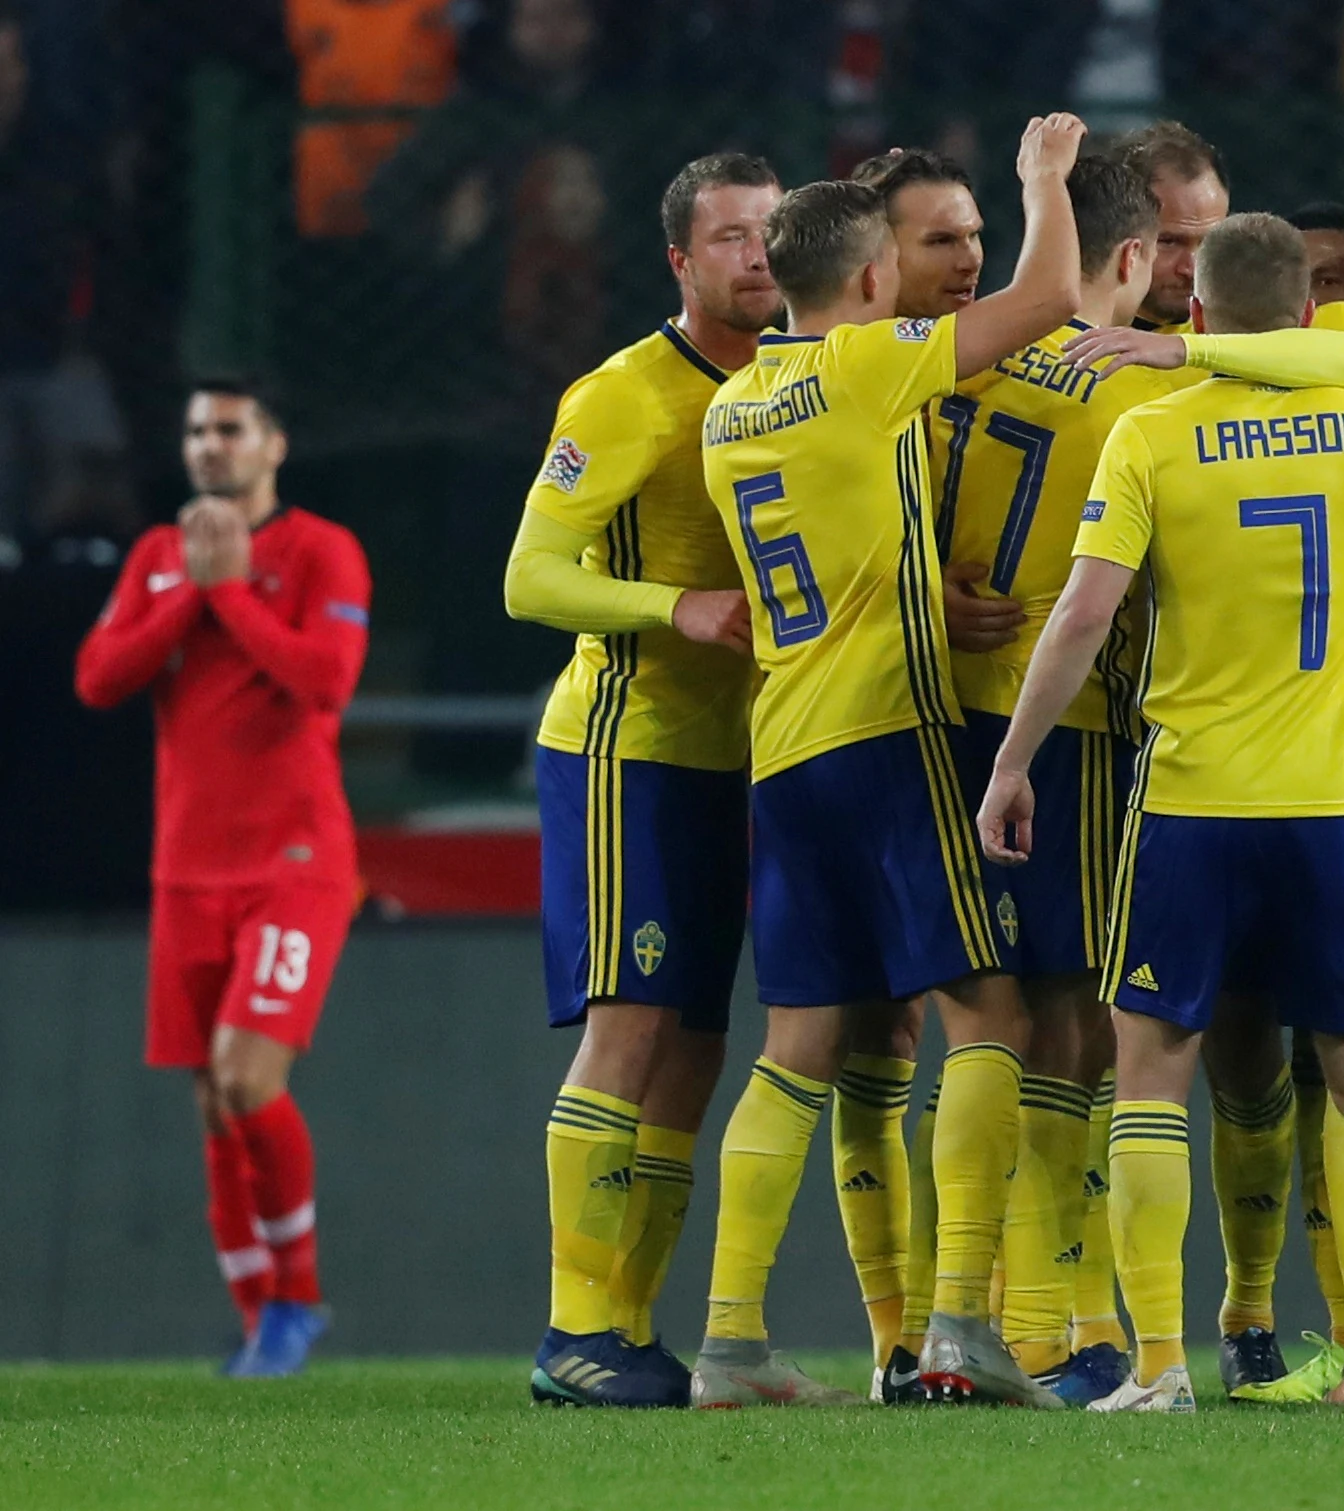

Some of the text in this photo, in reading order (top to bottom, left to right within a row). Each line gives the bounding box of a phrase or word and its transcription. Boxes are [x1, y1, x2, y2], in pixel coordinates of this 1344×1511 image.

[992, 346, 1099, 404] ESSON
[936, 394, 1056, 596] 17
[733, 471, 828, 648] 6
[1239, 494, 1330, 670] 7
[252, 925, 311, 992] 13
[1127, 975, 1159, 991] adidas
